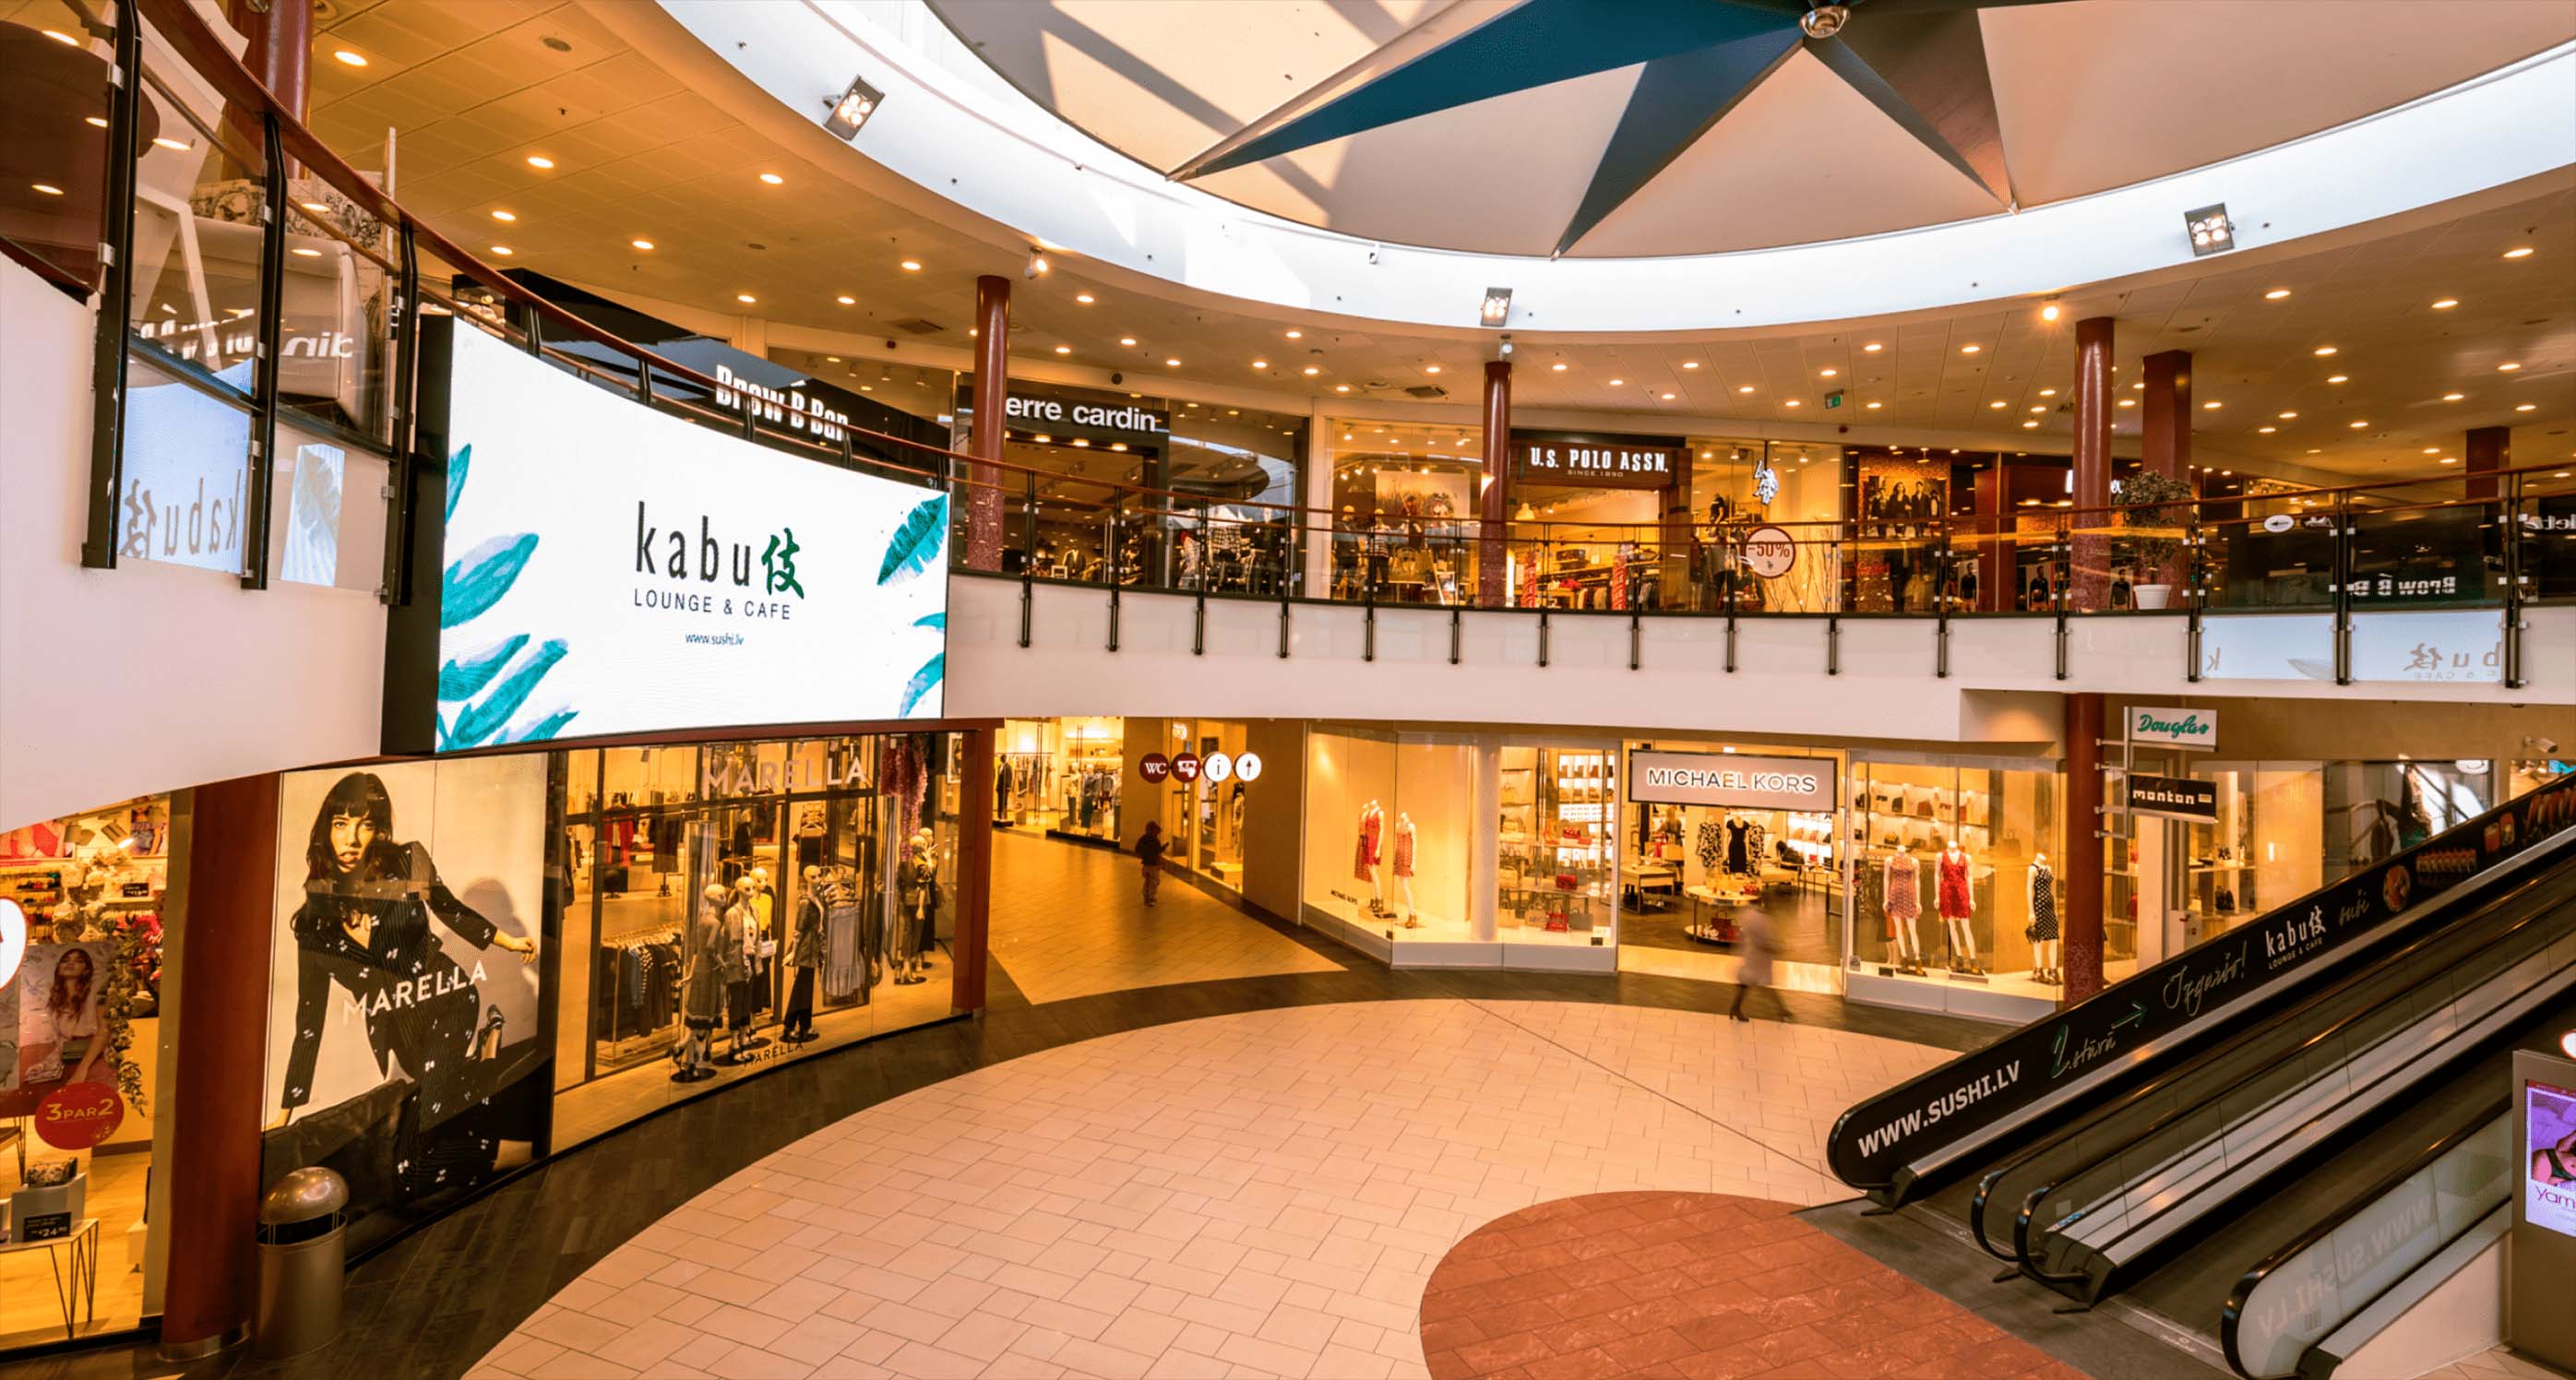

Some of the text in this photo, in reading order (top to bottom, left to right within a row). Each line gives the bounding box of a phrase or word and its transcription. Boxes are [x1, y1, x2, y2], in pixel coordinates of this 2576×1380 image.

[715, 363, 849, 442] Brow B Bar
[1005, 396, 1156, 432] erre cardin
[1530, 446, 1669, 473] U.S. POLO ASSN.
[1748, 541, 1790, 558] -50%
[634, 588, 791, 620] LOUNGE & CAFE
[685, 632, 745, 646] www.sushi.lv
[2137, 713, 2210, 739] Douglas
[701, 755, 867, 802] MARELLA
[1144, 762, 1167, 775] WC
[1647, 768, 1817, 793] MICHAEL KORS
[2132, 789, 2195, 805] monton
[342, 959, 488, 1027] MARELLA
[1857, 1060, 2021, 1159] WWW.SUSHI.LV
